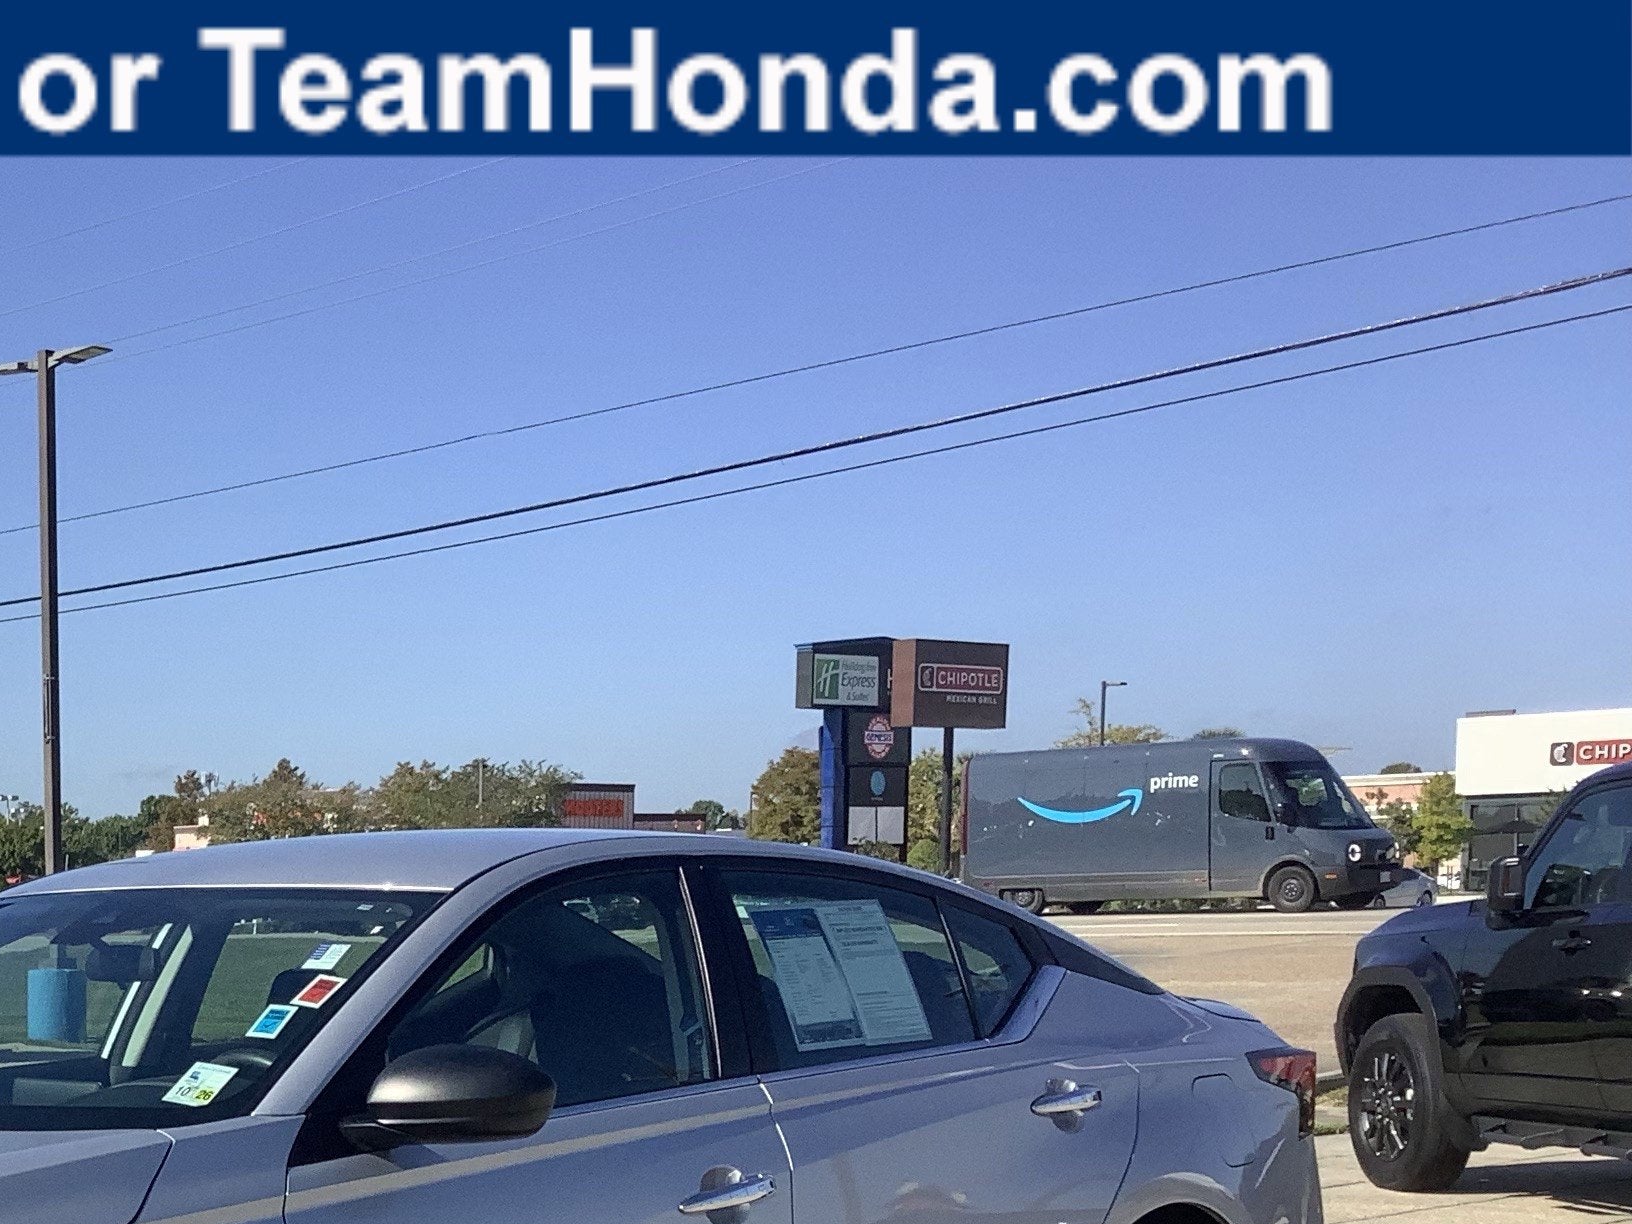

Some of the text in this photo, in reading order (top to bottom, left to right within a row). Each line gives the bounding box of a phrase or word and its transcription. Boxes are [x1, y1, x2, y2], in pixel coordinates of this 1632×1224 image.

[841, 671, 877, 689] Express
[938, 670, 999, 688] CHIPOTLE
[946, 695, 998, 705] MEXICAN GRILL
[1150, 772, 1199, 793] prime
[175, 1085, 215, 1101] 10 26
